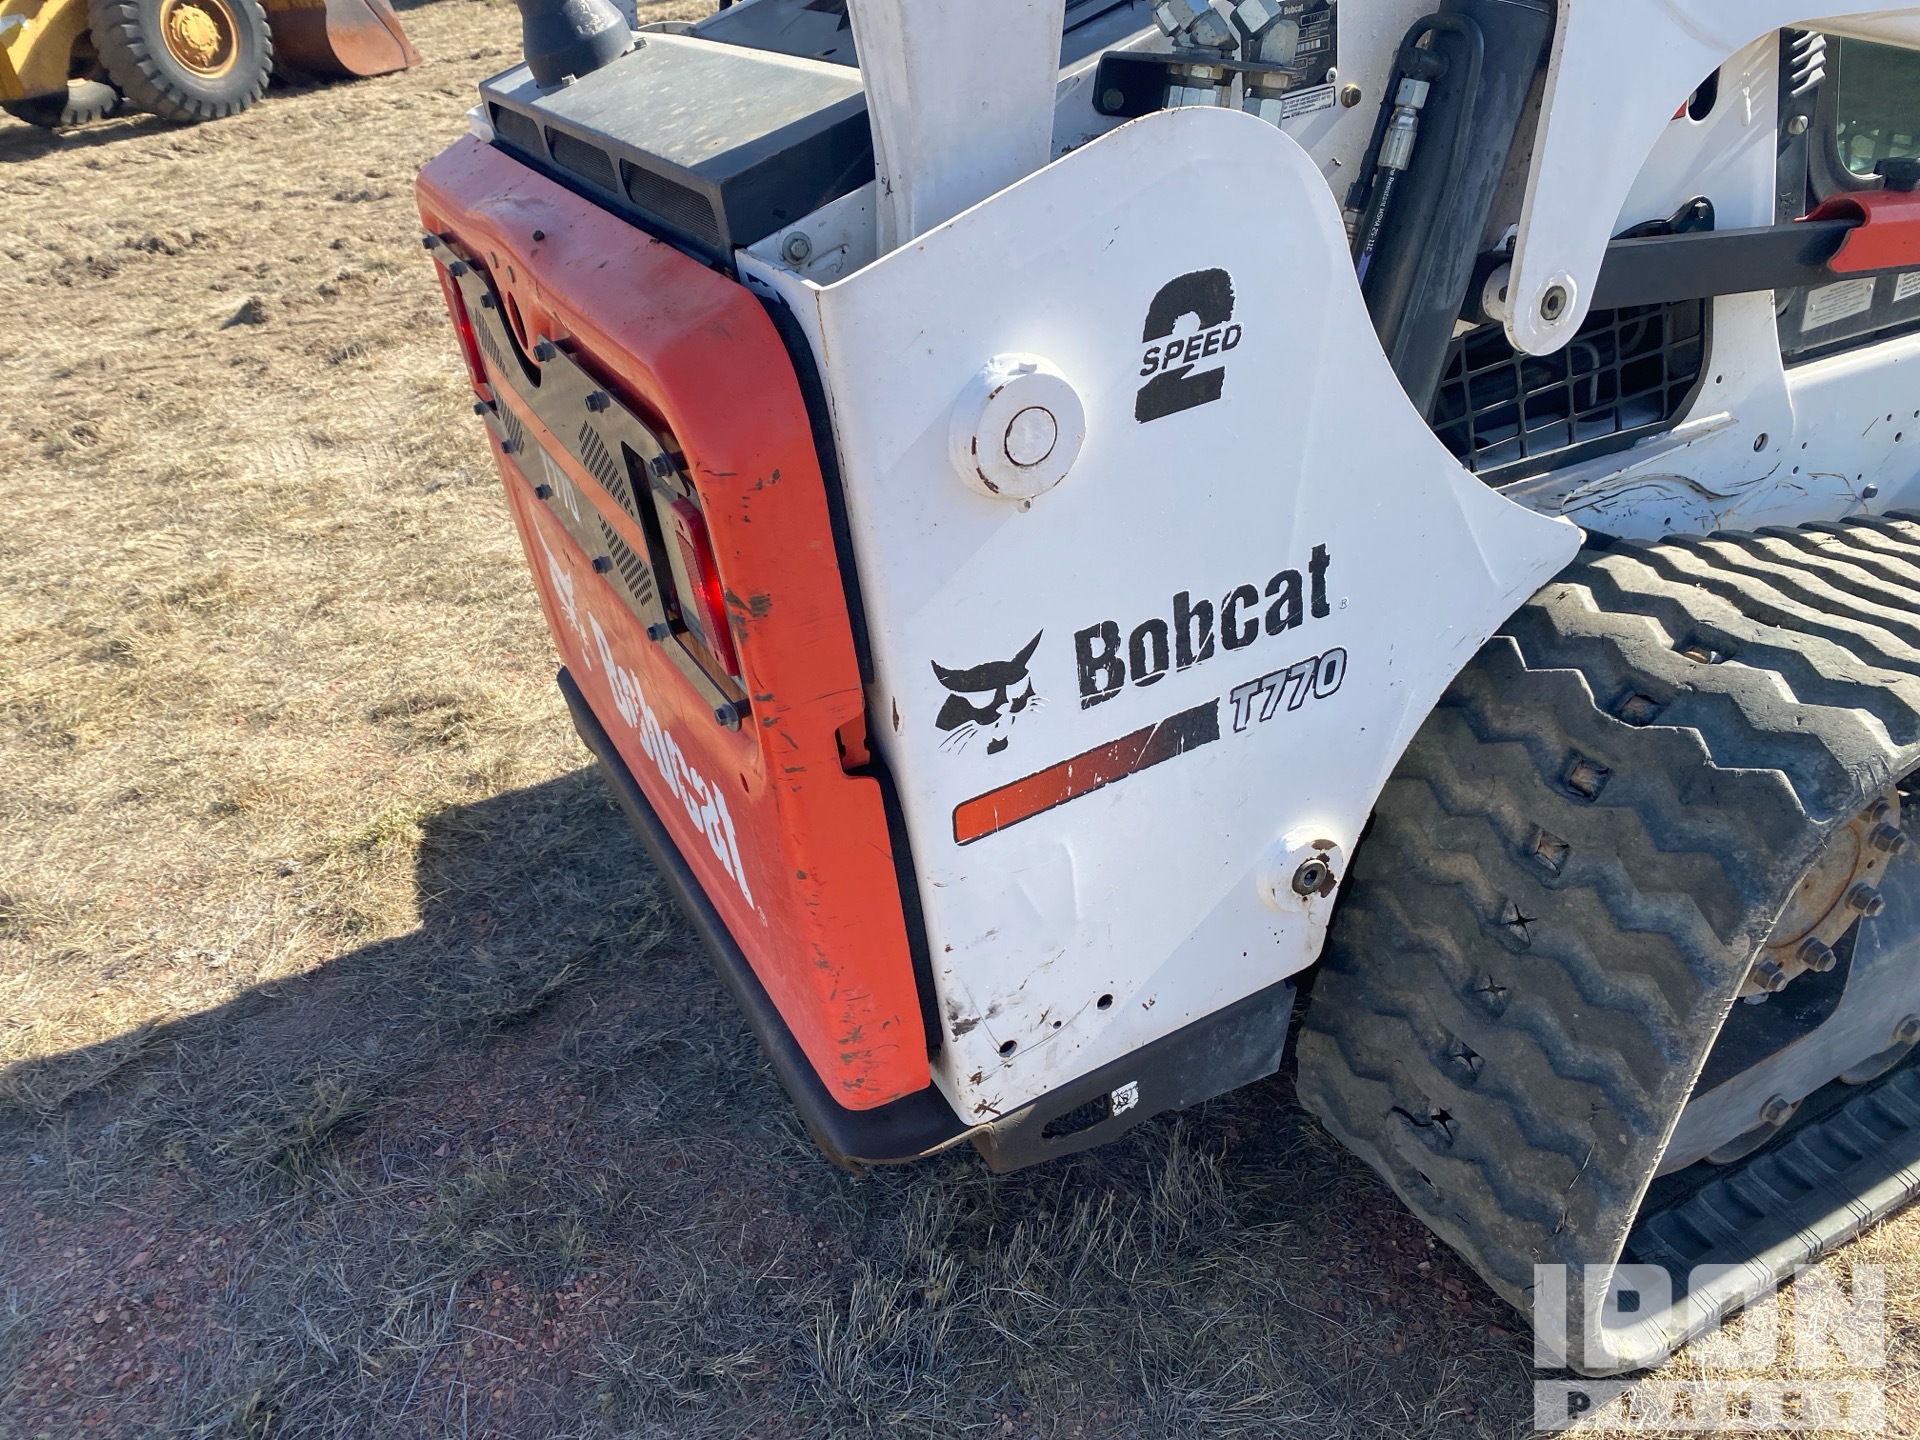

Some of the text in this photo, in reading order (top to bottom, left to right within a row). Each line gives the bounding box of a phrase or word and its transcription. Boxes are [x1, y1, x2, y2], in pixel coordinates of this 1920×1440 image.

[1284, 3, 1304, 15] Bobcat
[1374, 208, 1385, 227] MSHA
[1139, 323, 1243, 377] SPEED
[1073, 542, 1331, 711] Bobcat
[1229, 646, 1348, 733] T770
[587, 610, 755, 910] Bobcat
